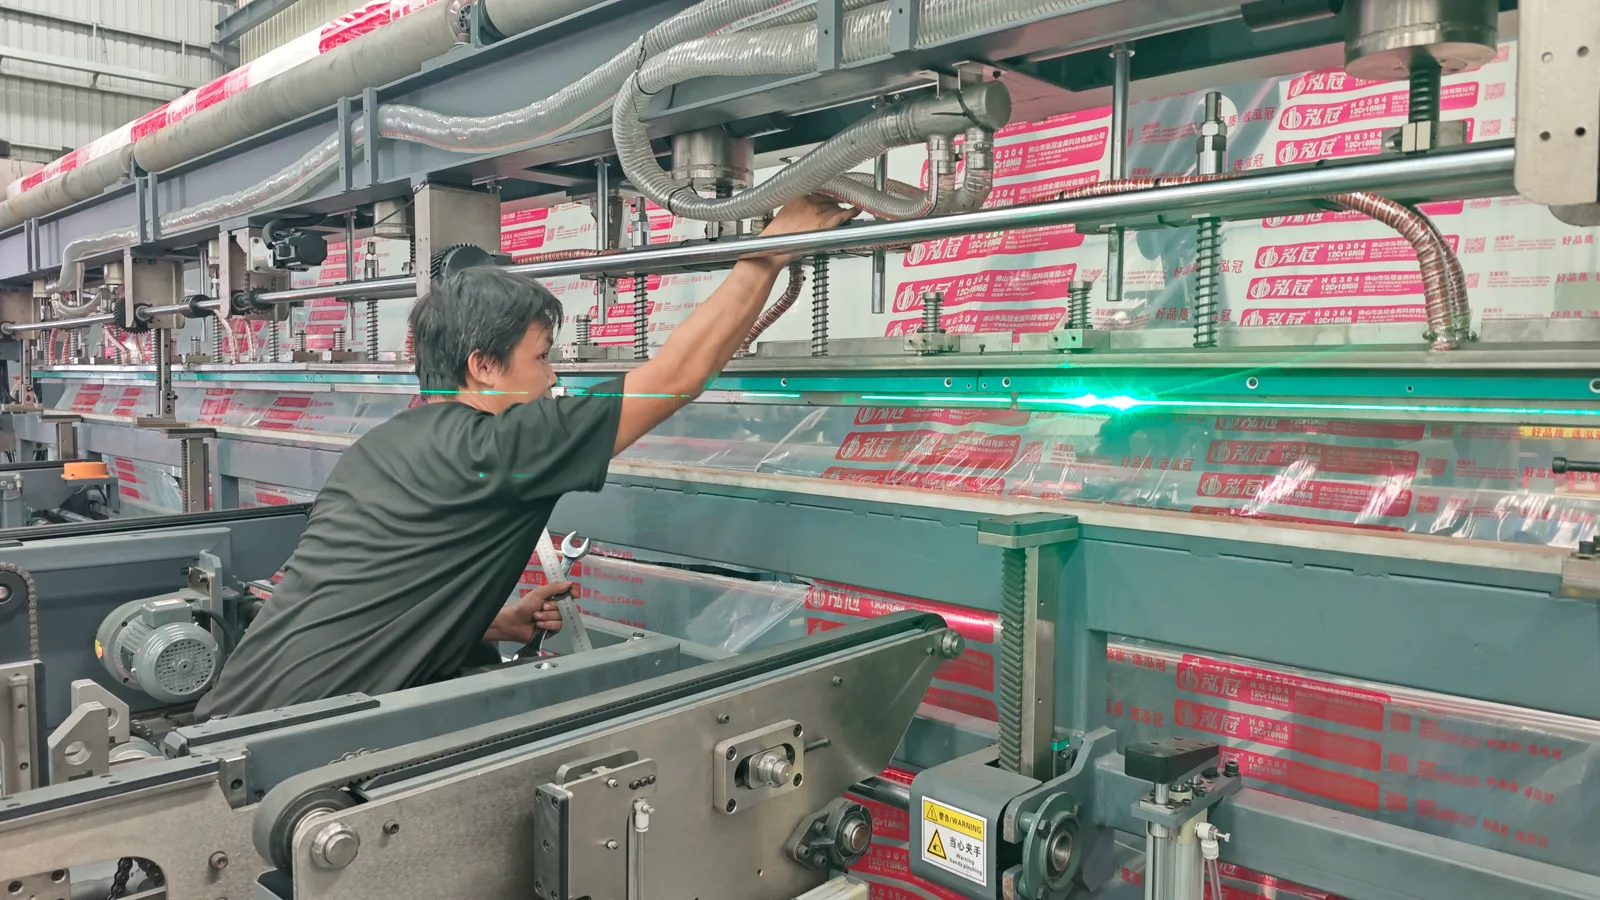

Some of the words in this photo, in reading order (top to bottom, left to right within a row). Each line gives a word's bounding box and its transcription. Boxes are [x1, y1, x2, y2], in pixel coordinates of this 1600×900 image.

[1304, 106, 1344, 125] 泓冠
[1299, 136, 1338, 159] 泓冠
[1279, 245, 1320, 264] 泓冠
[1271, 277, 1314, 296] 泓冠
[1232, 444, 1273, 463] 泓冠
[1201, 672, 1241, 698] 泓冠
[1200, 709, 1241, 735] 泓冠
[949, 836, 982, 858] 当心夹手
[949, 857, 963, 868] hands
[963, 863, 983, 877] pinching
[956, 853, 975, 866] Warning
